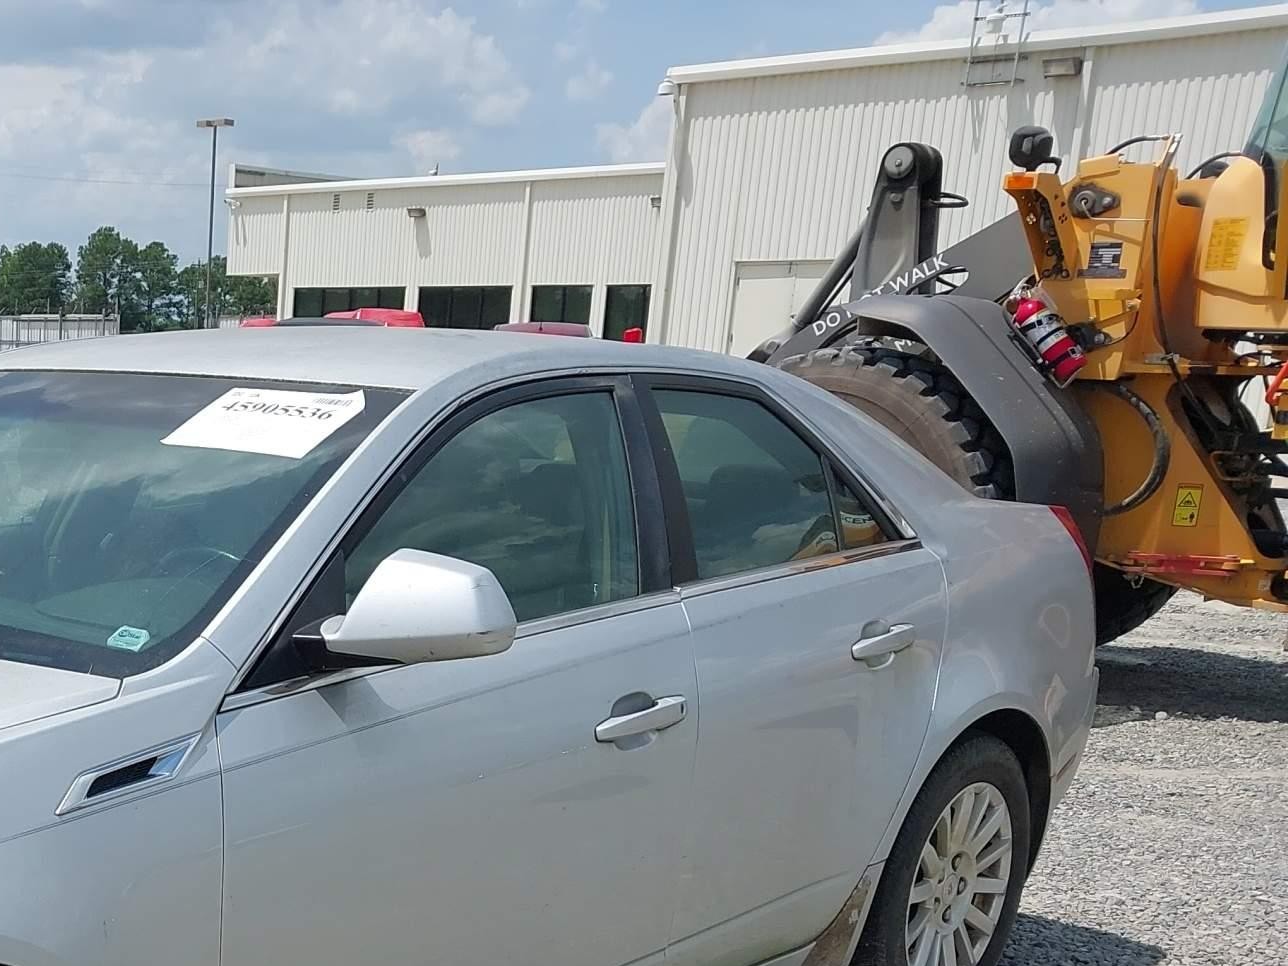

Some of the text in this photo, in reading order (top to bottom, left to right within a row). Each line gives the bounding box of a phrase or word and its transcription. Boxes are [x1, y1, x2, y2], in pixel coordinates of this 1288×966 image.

[812, 253, 949, 336] DO WALK
[221, 400, 335, 421] 45905536
